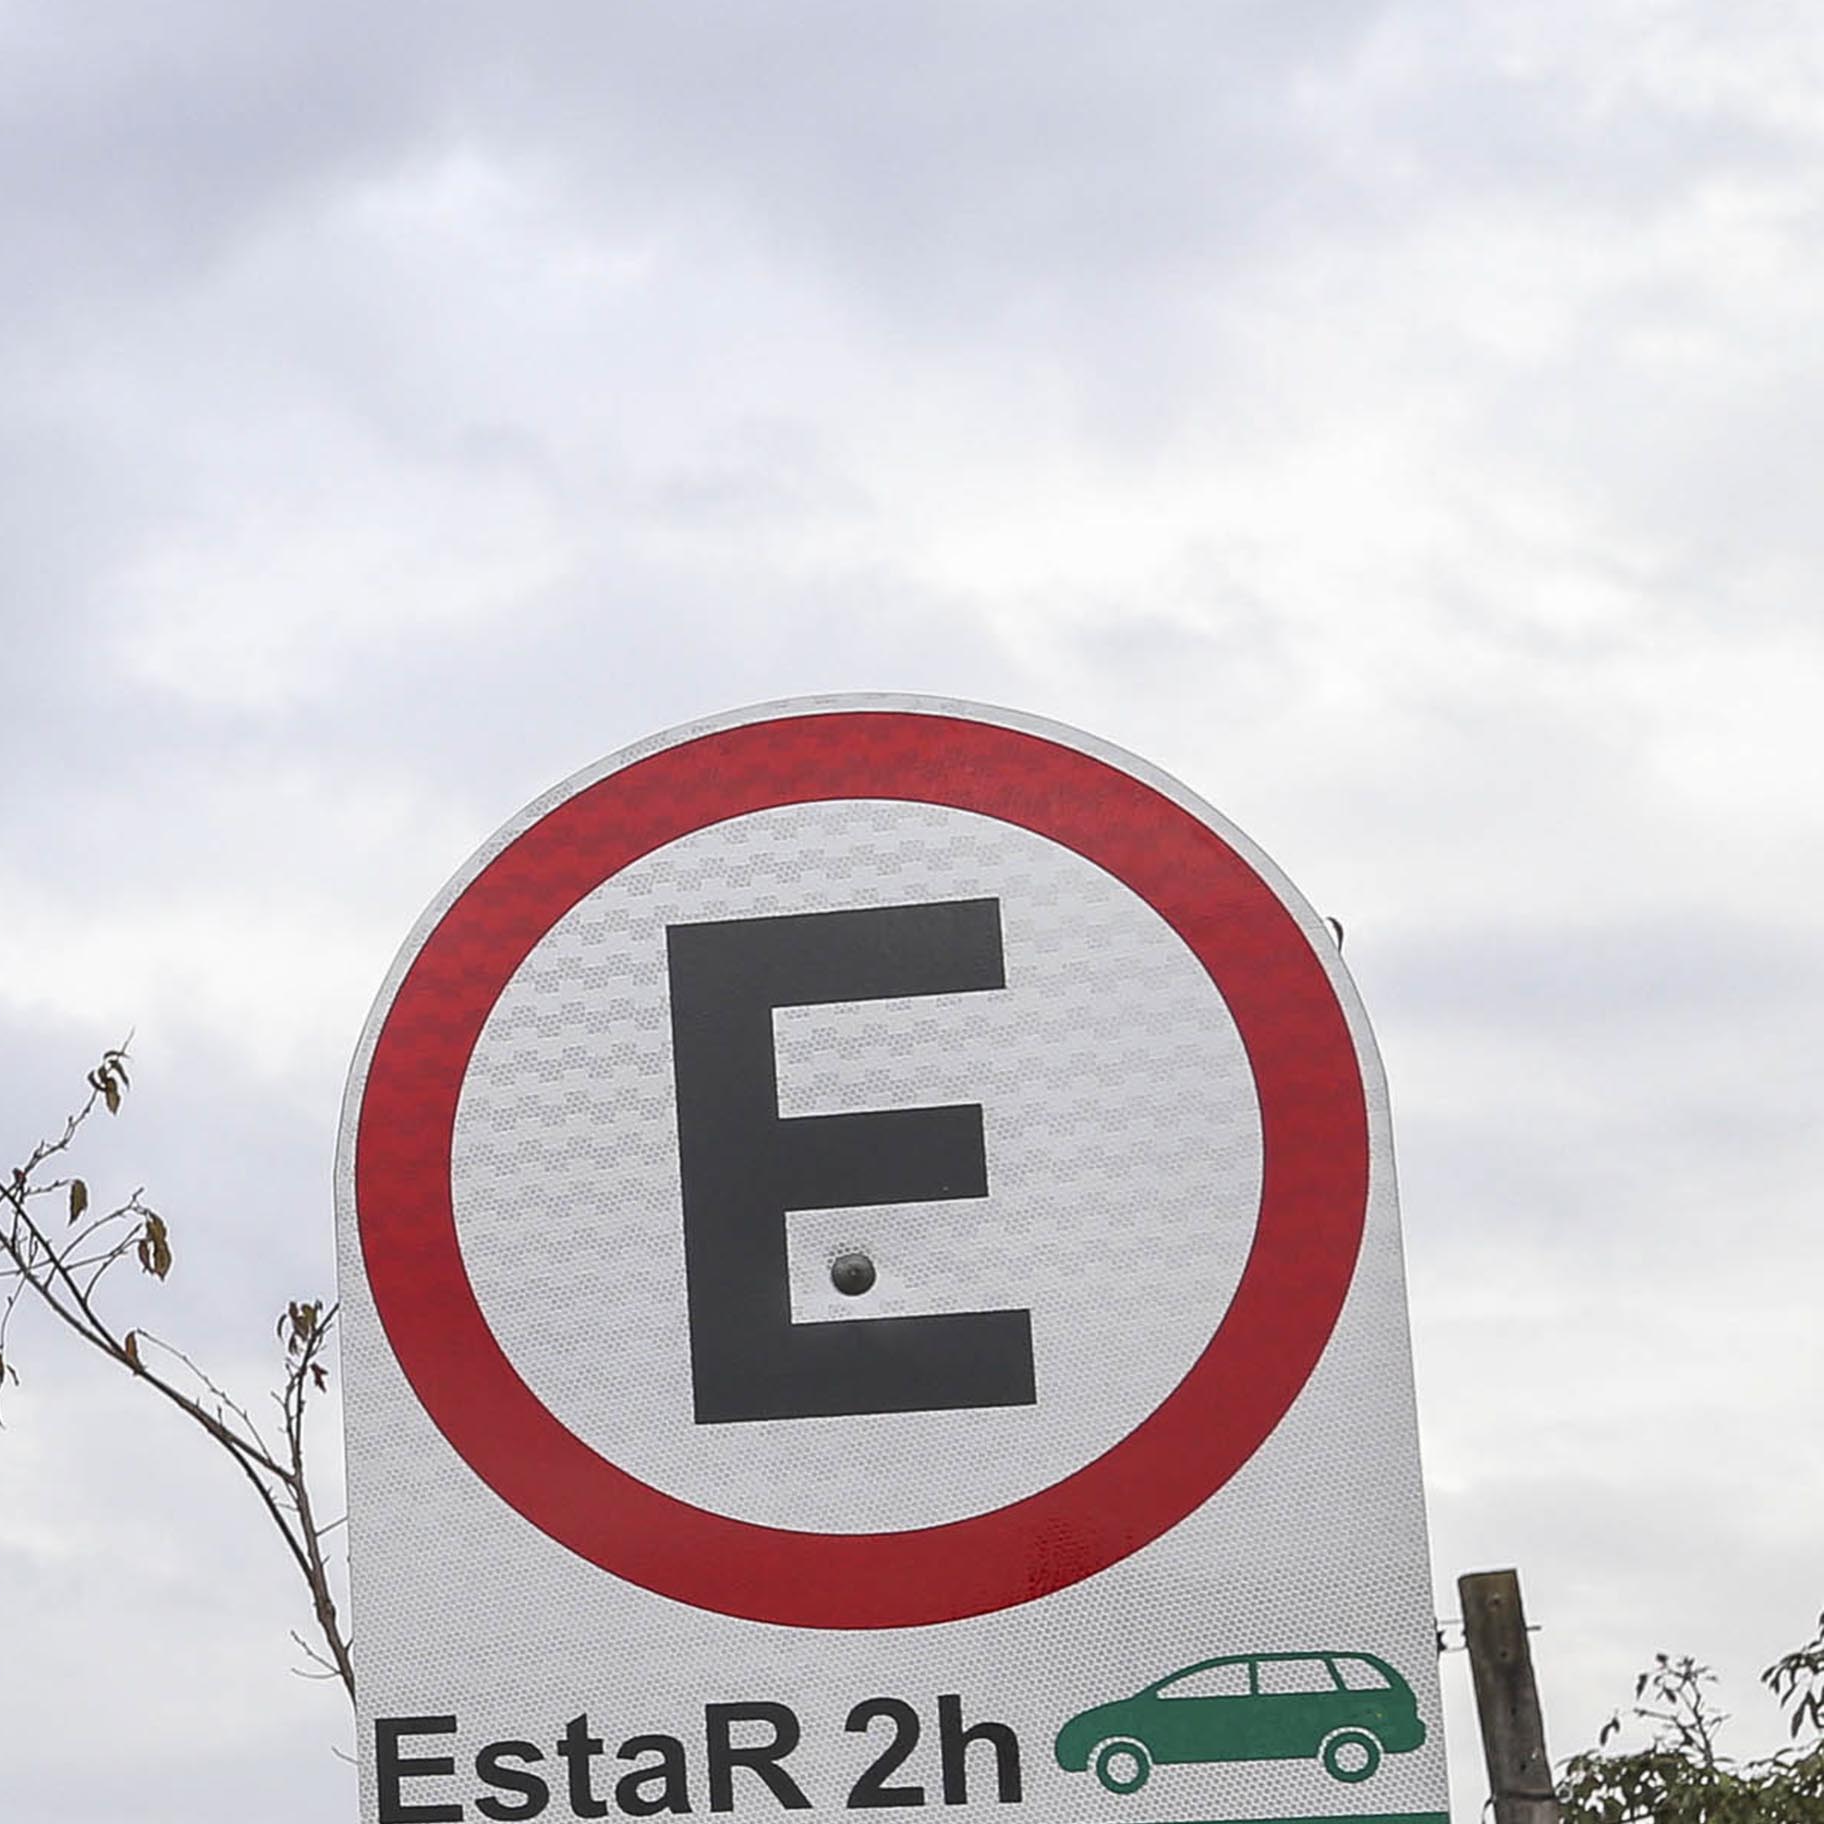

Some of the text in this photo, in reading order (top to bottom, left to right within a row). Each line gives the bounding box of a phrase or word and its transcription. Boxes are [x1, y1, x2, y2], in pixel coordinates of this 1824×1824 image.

[667, 898, 1036, 1425] E
[375, 1694, 1022, 1824] EstaR 2h
